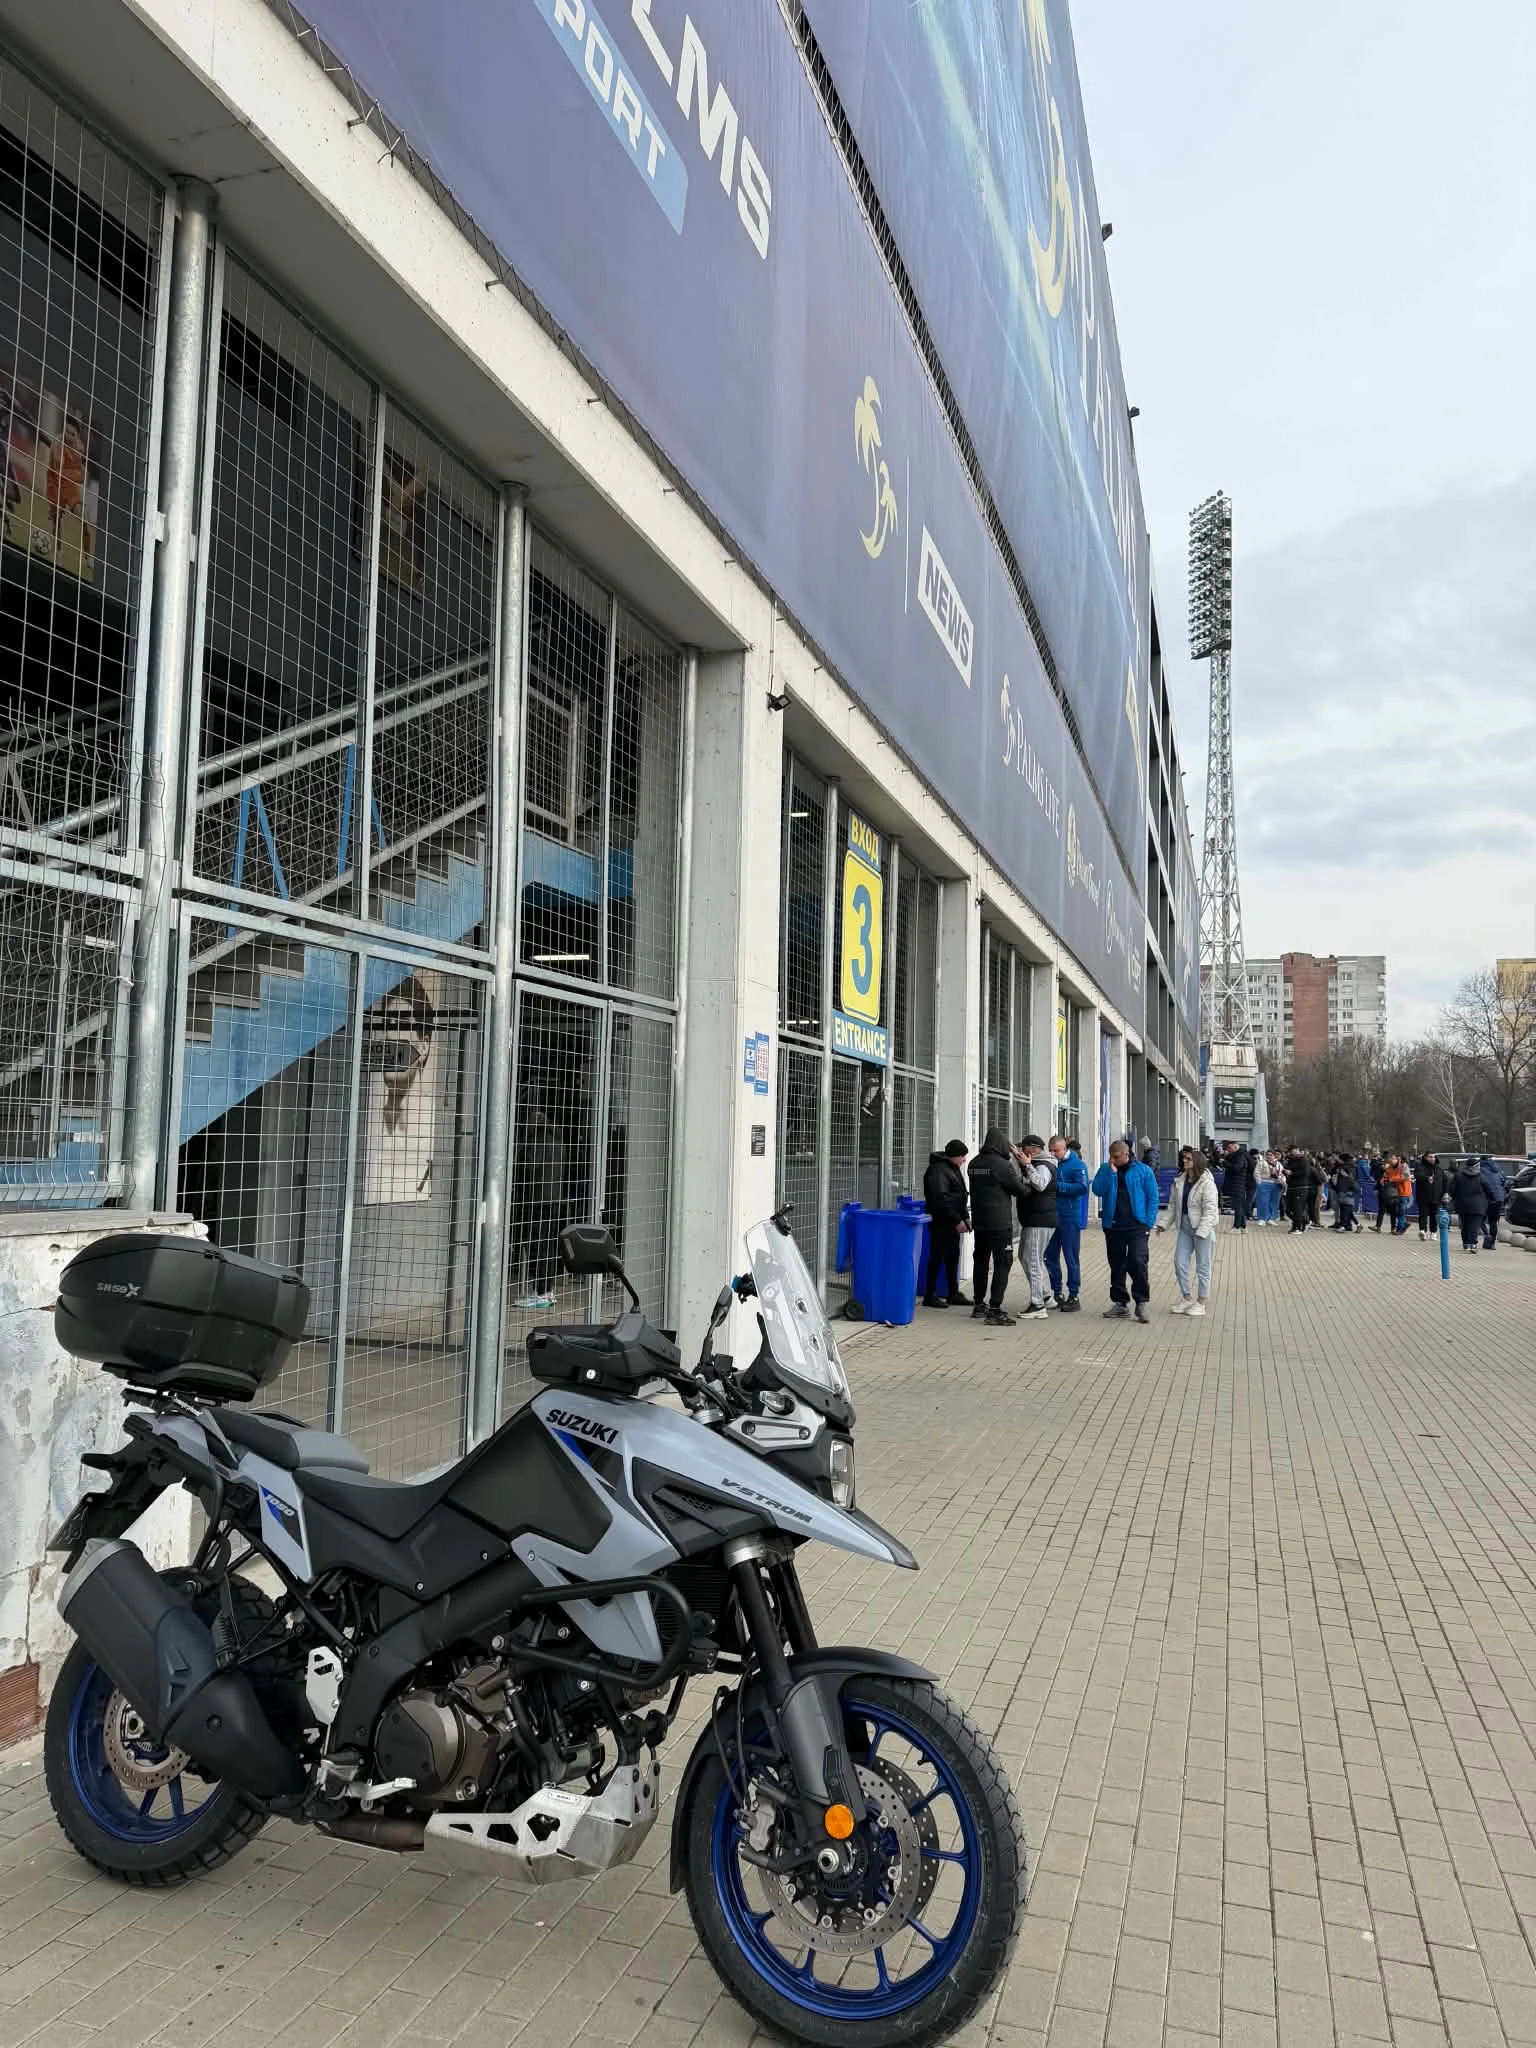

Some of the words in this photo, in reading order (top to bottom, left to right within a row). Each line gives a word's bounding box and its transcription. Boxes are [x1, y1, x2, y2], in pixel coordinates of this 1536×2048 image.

[1076, 160, 1137, 624] PALMS
[925, 551, 969, 667] NEWS
[1016, 709, 1045, 809] PALMS
[851, 815, 879, 866] ВХОД
[851, 884, 873, 995] 3
[834, 1018, 887, 1059] ENTRANCE
[546, 1409, 619, 1444] SUZUKI
[265, 1494, 295, 1517] 1050
[721, 1477, 813, 1523] V-STROM
